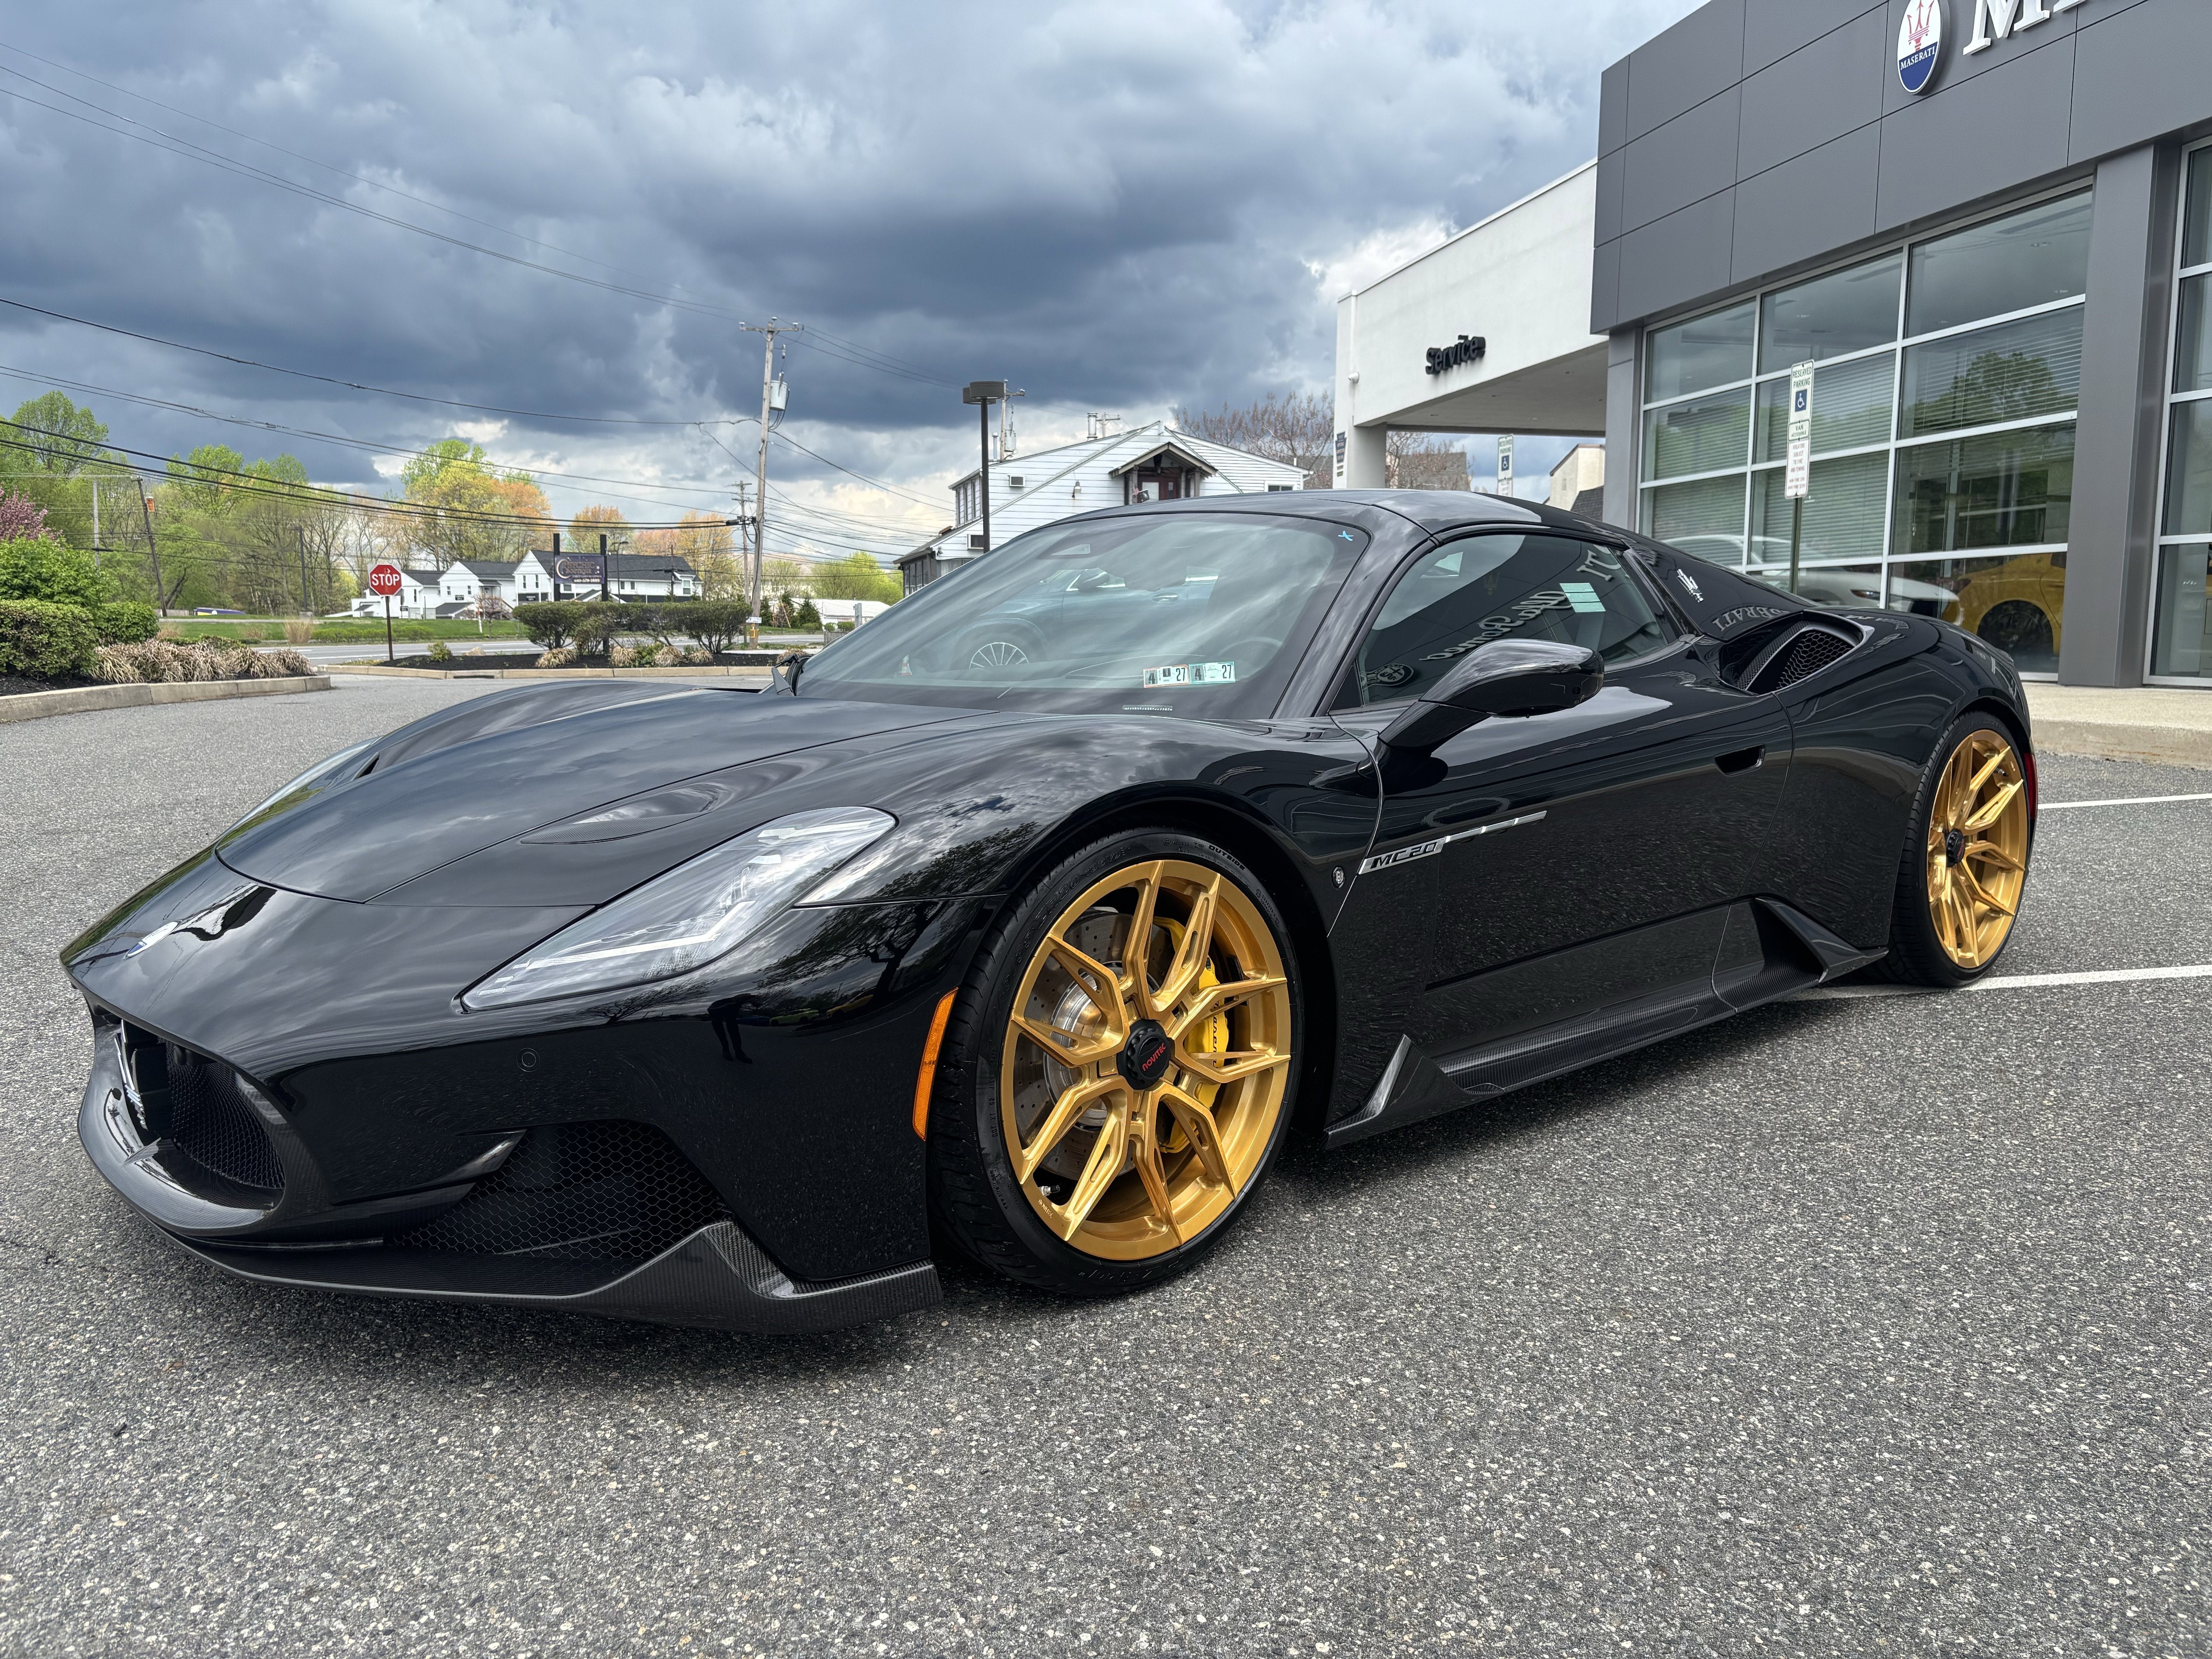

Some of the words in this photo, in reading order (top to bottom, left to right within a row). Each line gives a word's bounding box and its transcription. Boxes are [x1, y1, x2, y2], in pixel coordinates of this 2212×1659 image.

[1900, 46, 1935, 70] MASERATI
[1425, 335, 1486, 374] Service
[1793, 366, 1812, 378] RESERVED
[1793, 378, 1810, 389] PARKING
[372, 574, 400, 586] STOP
[1148, 672, 1156, 685] 4
[1176, 667, 1186, 682] 27
[1194, 668, 1202, 681] 4
[1222, 664, 1232, 679] 27
[1208, 844, 1245, 871] OUTSIDE
[1370, 842, 1438, 869] MC20
[1142, 1042, 1166, 1072] NOVITEC
